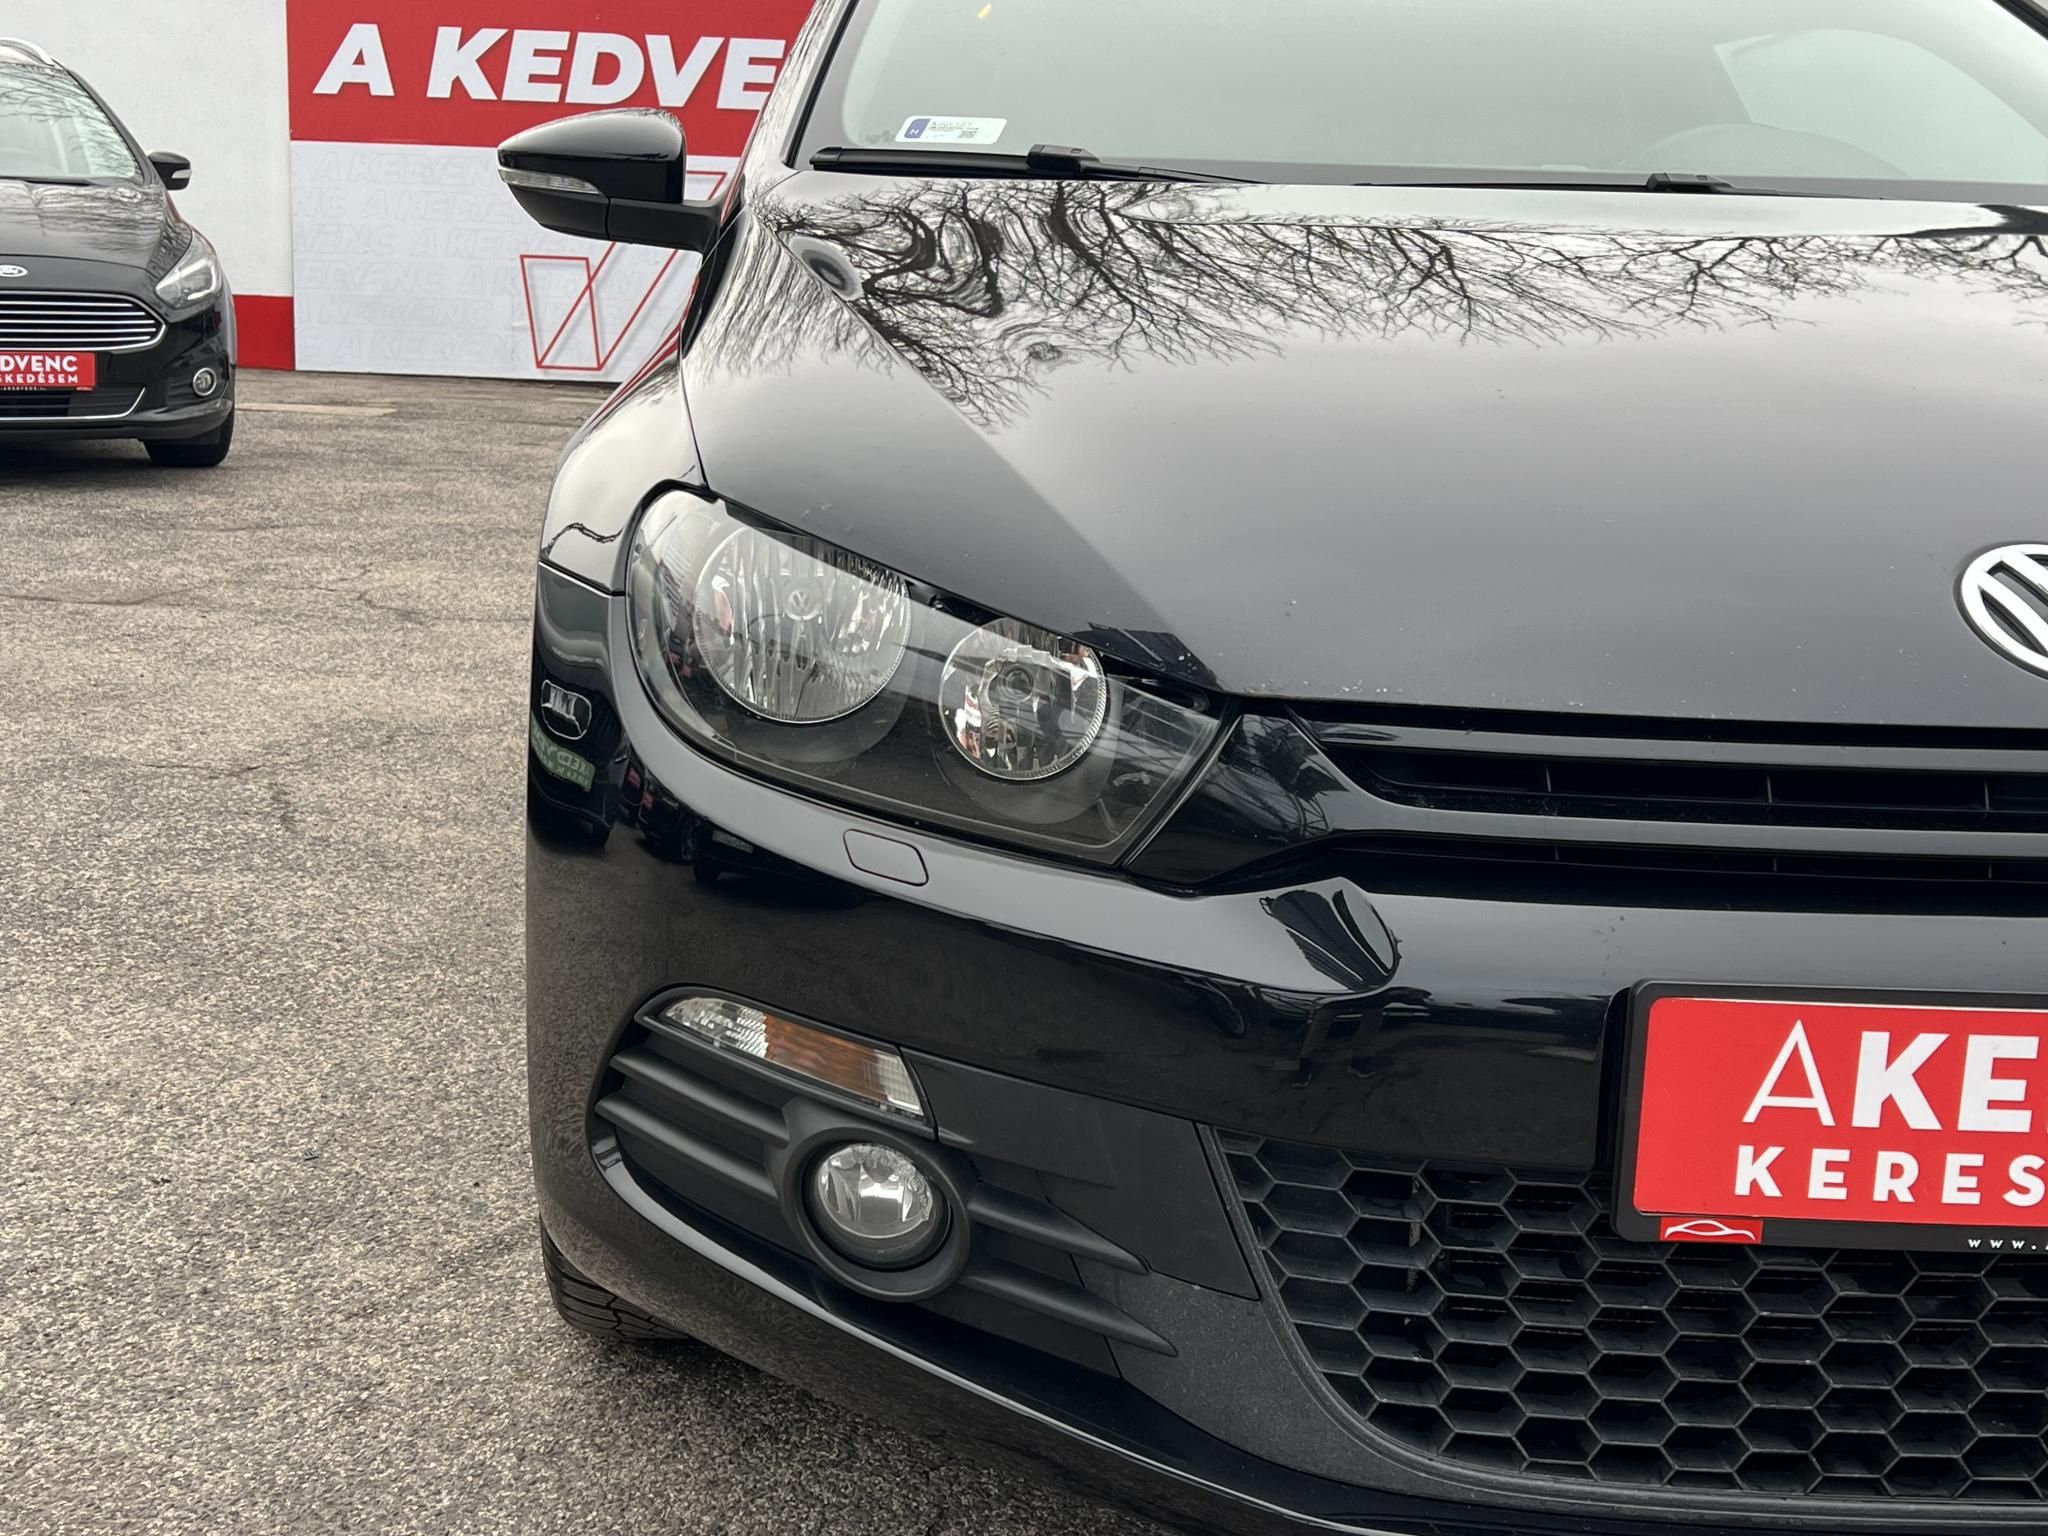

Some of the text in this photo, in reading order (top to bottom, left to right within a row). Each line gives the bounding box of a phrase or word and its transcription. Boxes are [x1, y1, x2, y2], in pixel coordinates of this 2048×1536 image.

[312, 23, 787, 111] A KEDVE
[0, 355, 79, 372] DVENC
[1734, 1144, 2047, 1207] KERES
[1968, 1239, 2048, 1250] www.
